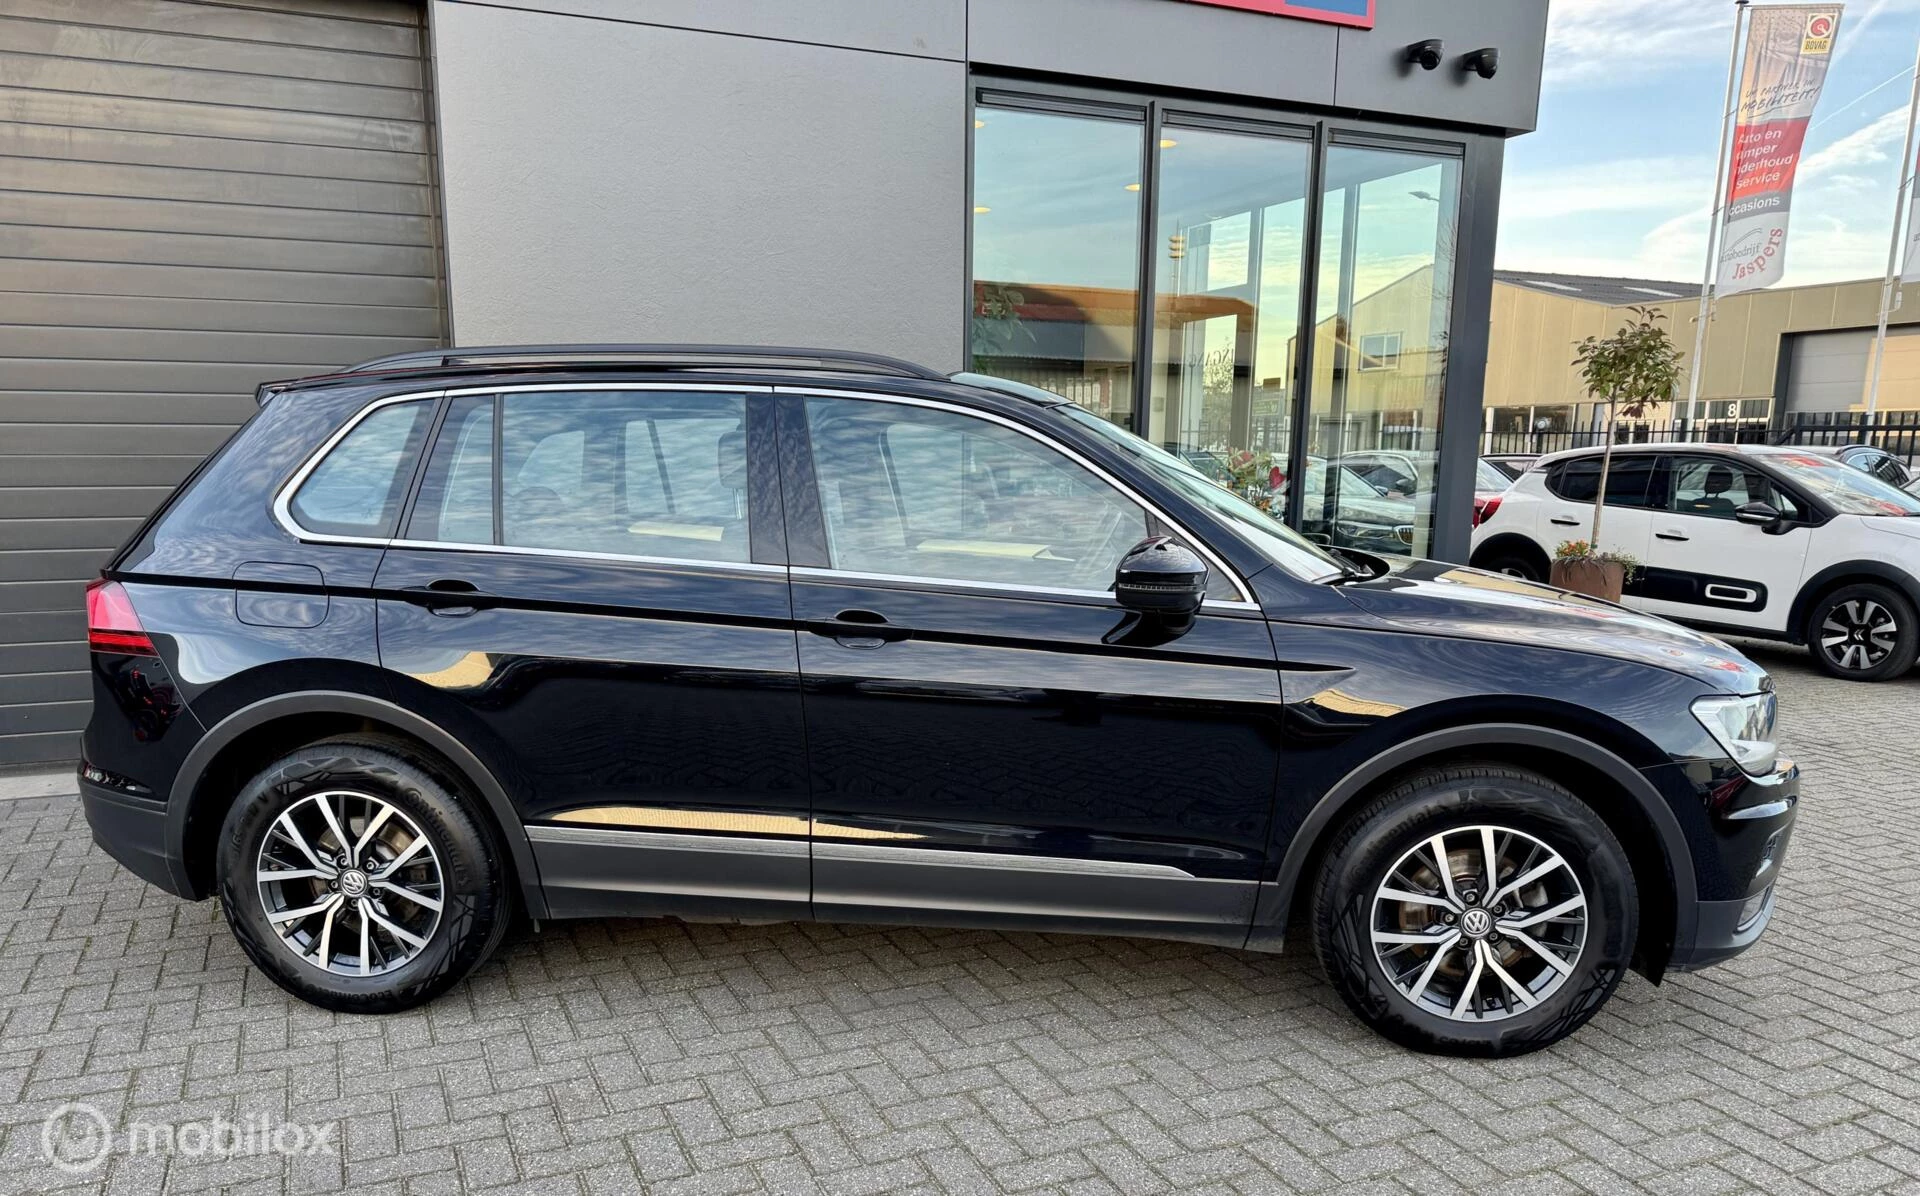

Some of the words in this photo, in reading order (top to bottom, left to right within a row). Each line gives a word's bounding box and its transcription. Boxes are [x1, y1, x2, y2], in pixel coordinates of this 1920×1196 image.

[1765, 130, 1782, 140] en
[1736, 171, 1780, 189] service
[1732, 228, 1783, 280] Jaspers
[1727, 403, 1737, 417] 8
